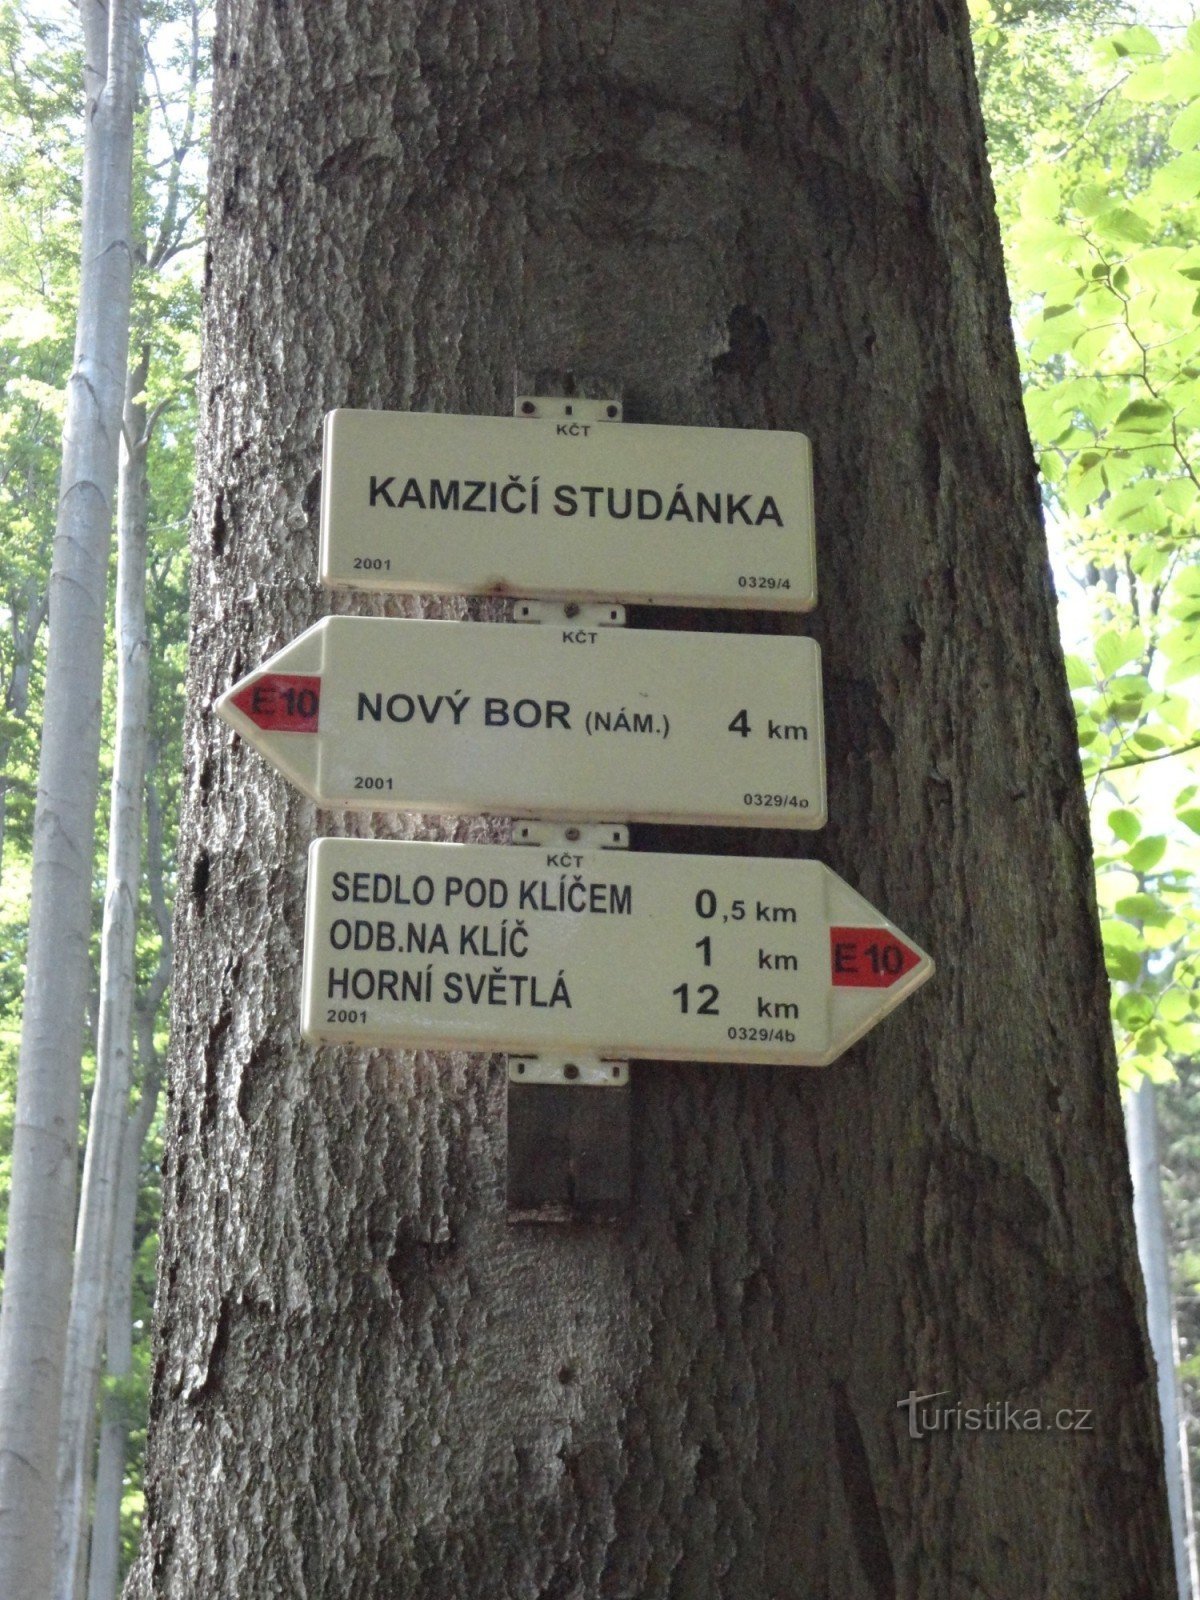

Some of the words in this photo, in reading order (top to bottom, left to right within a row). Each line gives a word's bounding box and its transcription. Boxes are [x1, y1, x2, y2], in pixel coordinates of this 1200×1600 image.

[556, 421, 591, 437] KČT
[368, 474, 540, 515] KAMZIČÍ
[553, 483, 784, 528] STUDÁNKA
[353, 557, 392, 571] 2001
[738, 576, 791, 590] 0329/4
[562, 629, 598, 644] KČT
[357, 689, 468, 726] NOVÝ
[484, 698, 571, 729] BOR
[585, 708, 670, 738] (NÁM.)
[728, 709, 751, 738] 4
[768, 722, 809, 741] km
[354, 776, 394, 790] 2001
[546, 852, 584, 868] KČT
[332, 872, 434, 904] SEDLO
[444, 876, 508, 909] POD
[519, 875, 633, 915] KLÍČEM
[756, 901, 797, 924] km
[460, 919, 529, 958] KLÍČ
[695, 936, 713, 967] 1
[758, 950, 799, 973] km
[328, 964, 432, 1002] HORNÍ
[443, 967, 572, 1009] SVĚTLÁ
[671, 982, 720, 1016] 12
[757, 997, 799, 1020] km
[327, 1010, 368, 1025] 2001
[728, 1026, 796, 1044] 0329/4b
